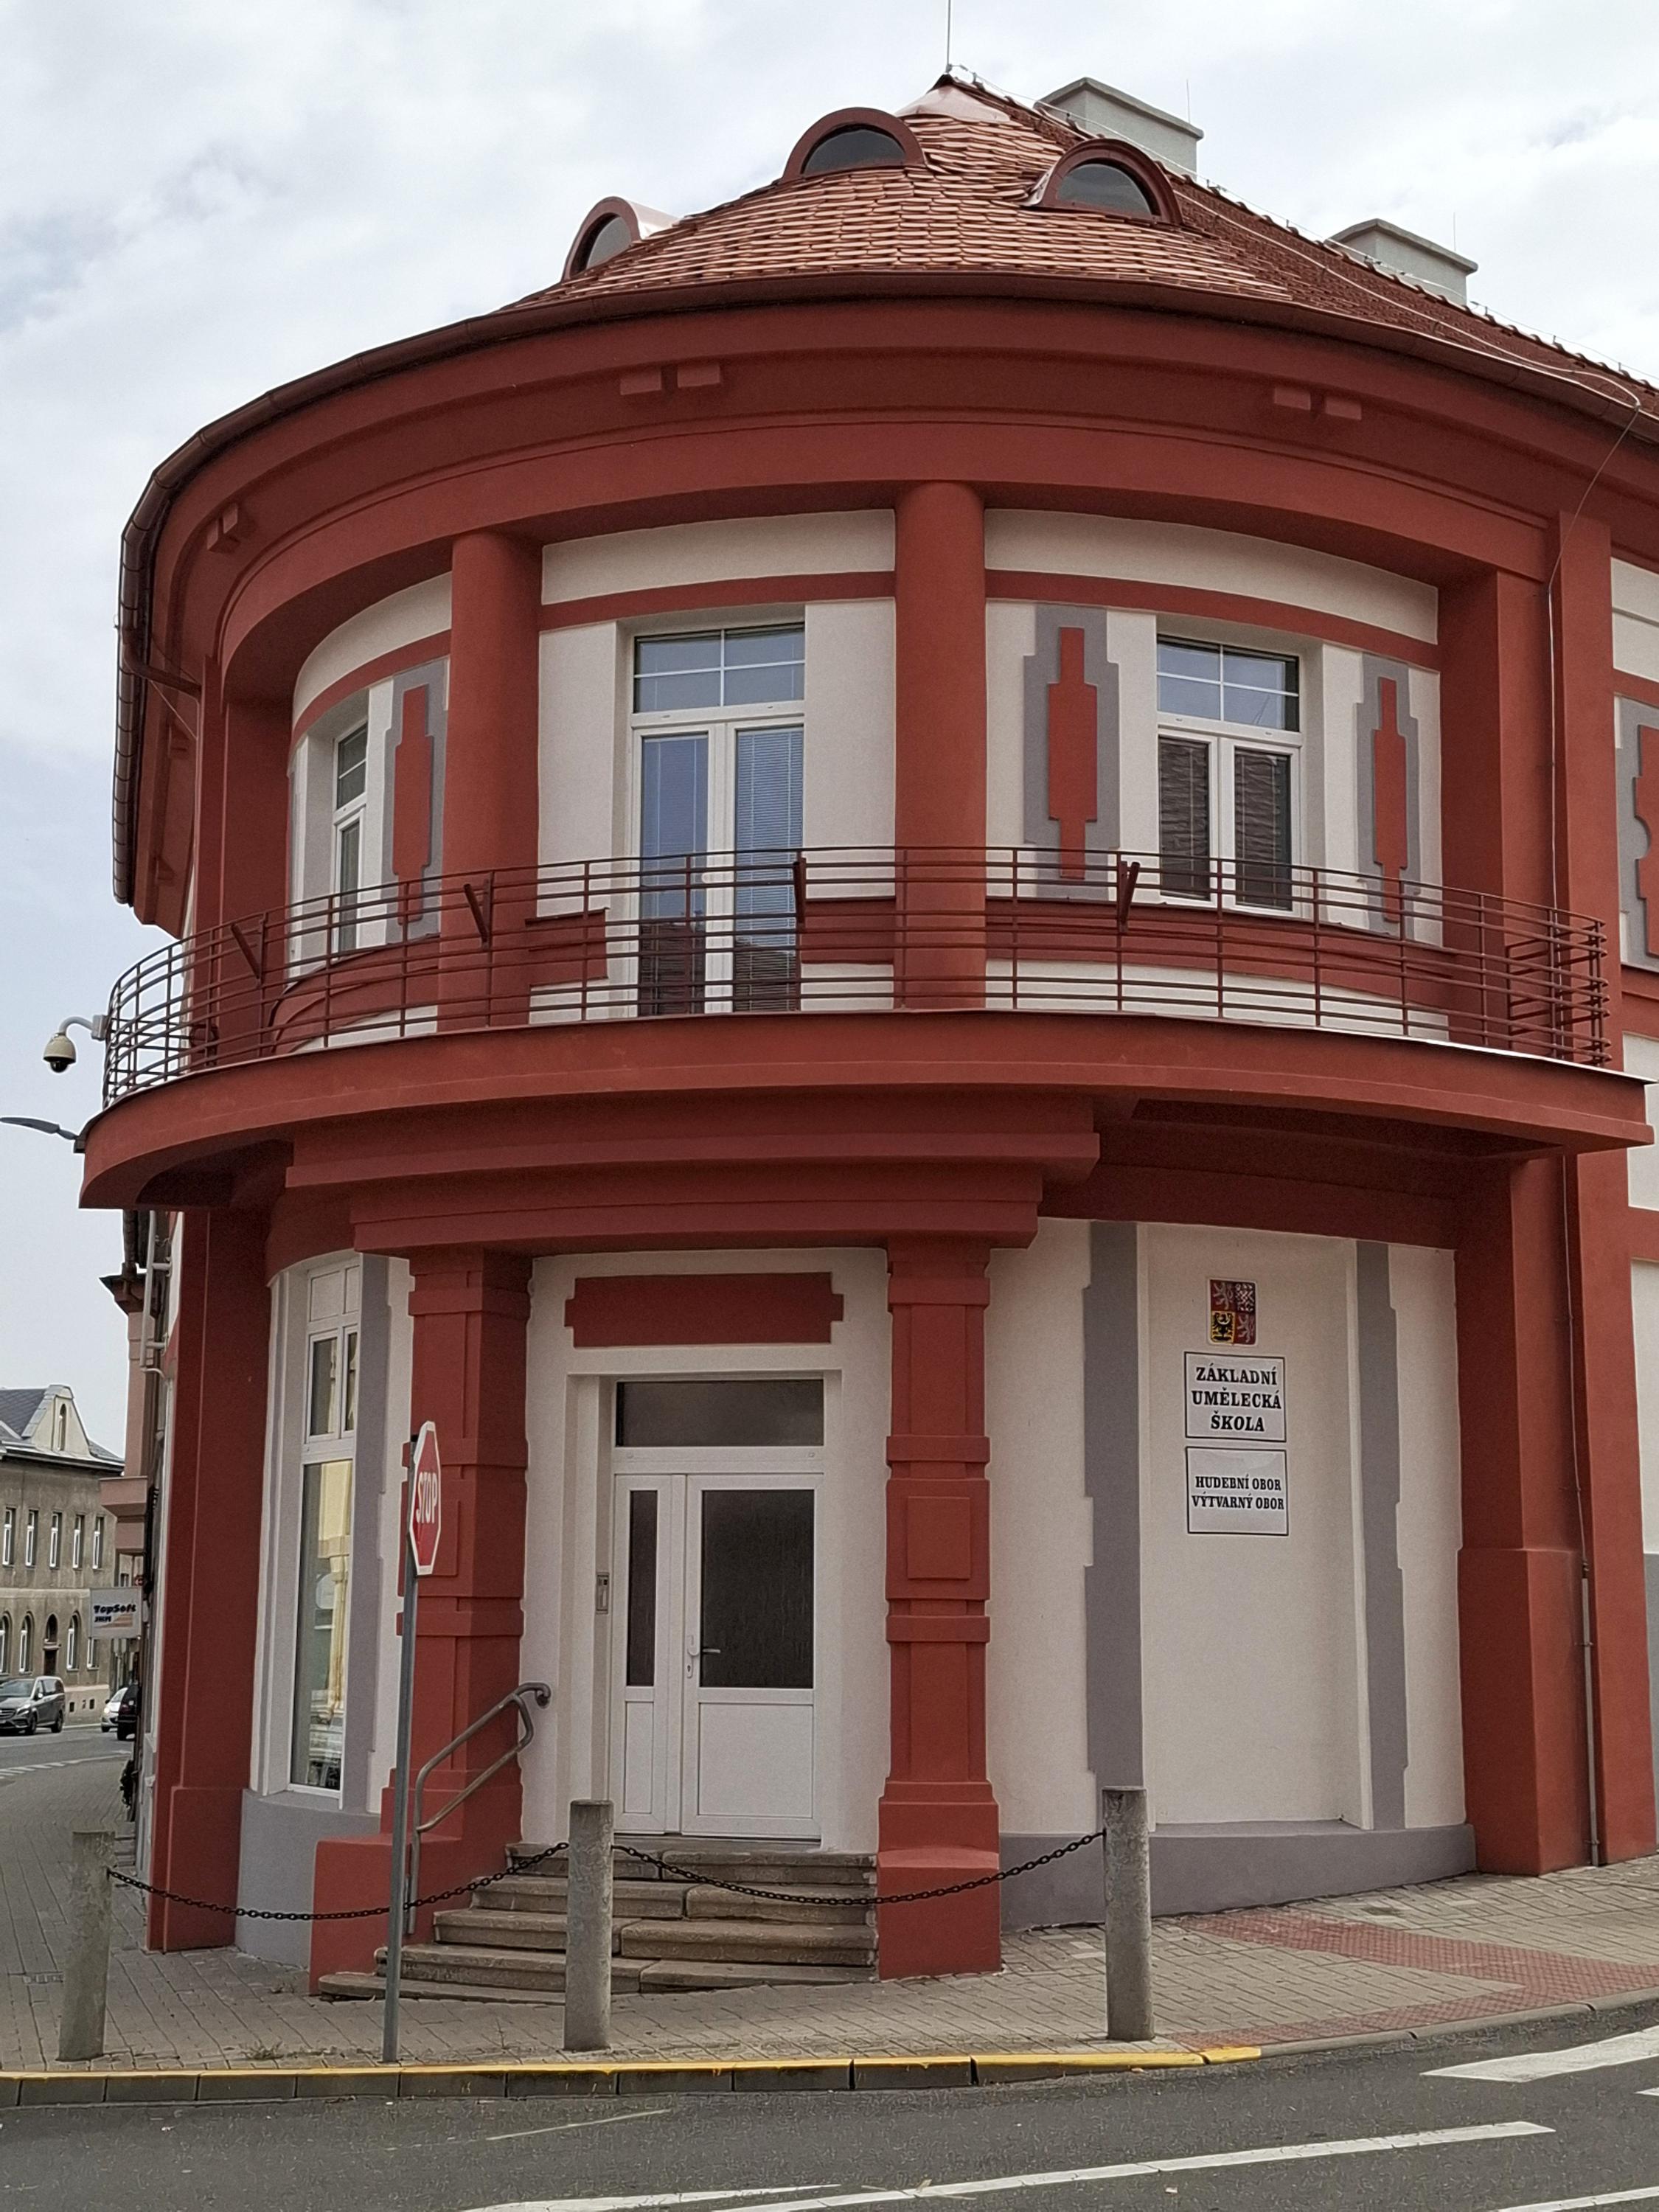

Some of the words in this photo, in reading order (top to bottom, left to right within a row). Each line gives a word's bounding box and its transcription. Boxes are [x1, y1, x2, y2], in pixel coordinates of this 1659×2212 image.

[1196, 1363, 1277, 1385] ZÁKLADNÍ
[1192, 1386, 1281, 1409] UMĚLECKÁ
[1211, 1410, 1265, 1432] ŠKOLA
[1195, 1473, 1249, 1489] HUDEBNÍ
[1252, 1478, 1281, 1491] OBOR
[416, 1472, 438, 1524] STOP
[1192, 1491, 1253, 1509] VÝTVARNÝ
[1256, 1497, 1284, 1509] OBOR
[93, 1604, 136, 1615] TopSoft
